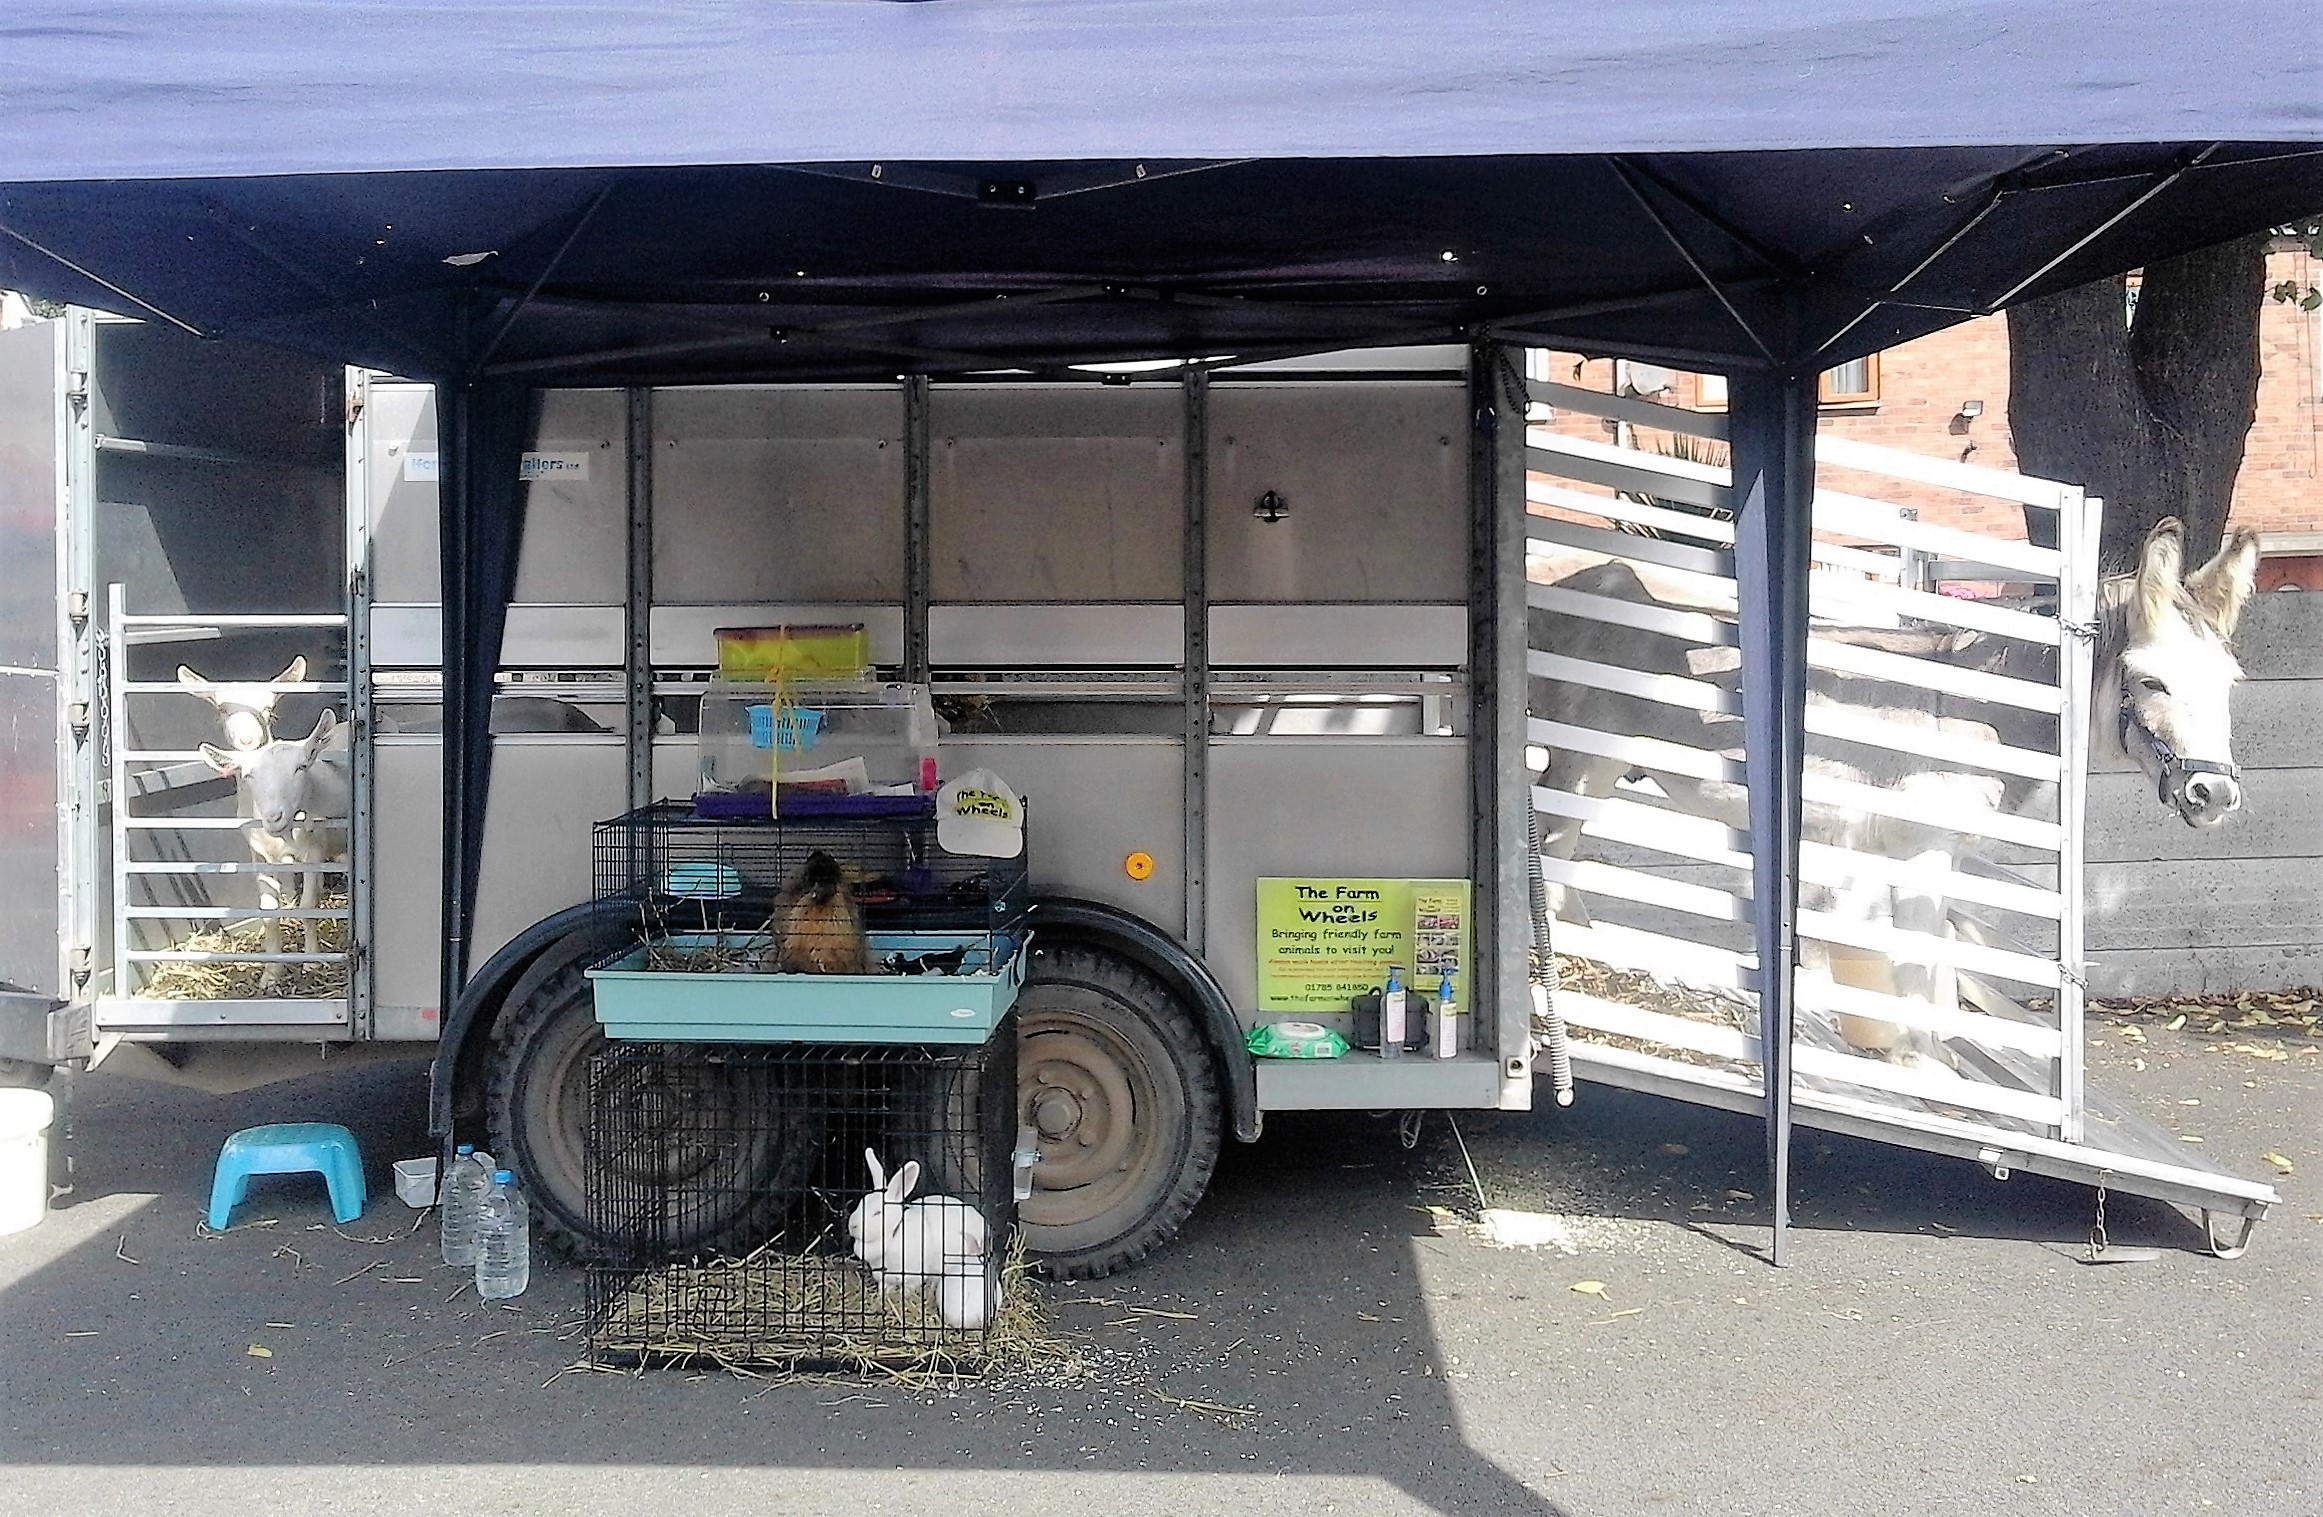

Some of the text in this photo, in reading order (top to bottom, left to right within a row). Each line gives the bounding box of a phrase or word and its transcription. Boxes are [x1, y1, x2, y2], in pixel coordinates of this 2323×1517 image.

[523, 457, 563, 470] ailers
[957, 790, 976, 803] The
[956, 805, 1008, 818] Wheels
[1295, 886, 1380, 900] The Farm
[1298, 907, 1378, 924] Wheels
[1333, 905, 1355, 914] on
[1272, 929, 1402, 941] Bringing friendly farm
[1278, 945, 1394, 957] animals to visit you!
[1305, 983, 1332, 991] 01785
